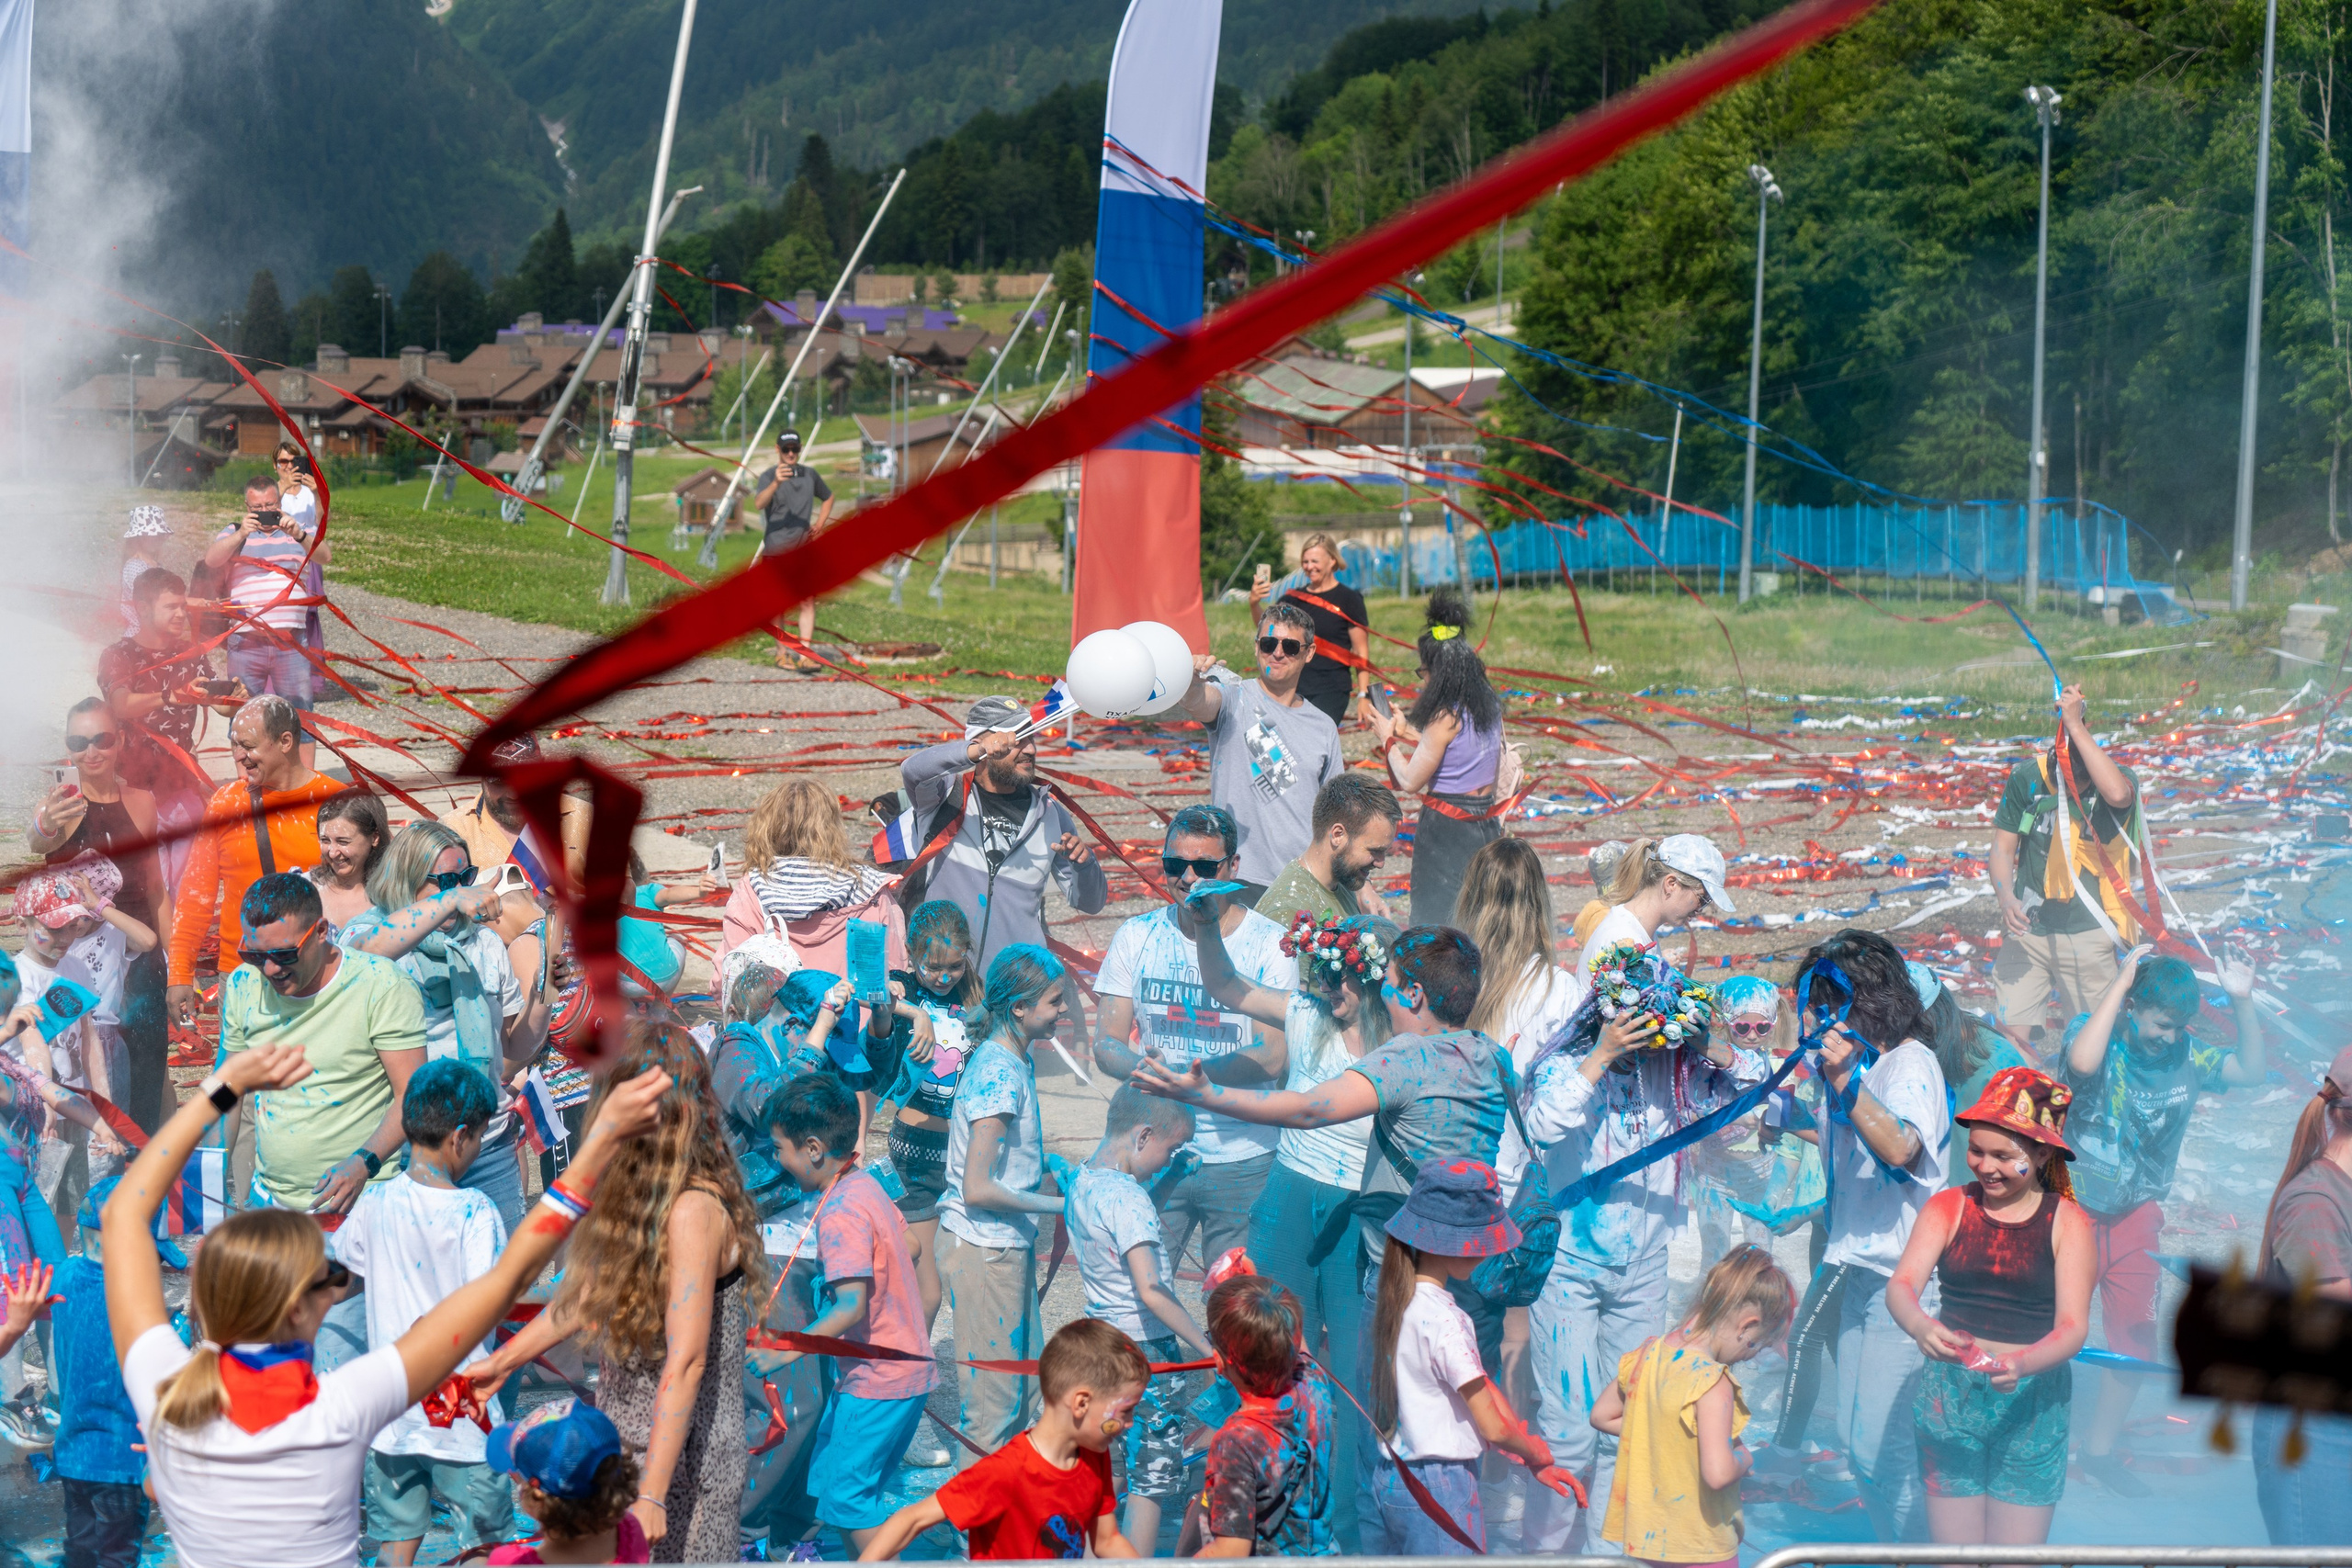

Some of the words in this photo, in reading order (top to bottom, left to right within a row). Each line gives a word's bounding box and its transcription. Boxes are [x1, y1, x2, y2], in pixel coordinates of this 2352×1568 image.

[1269, 730, 1297, 767] PARADISE
[1149, 982, 1203, 1007] DENIM
[1160, 1018, 1201, 1037] SINCE
[2137, 1098, 2163, 1108] YOUTH
[2164, 1093, 2188, 1106] SPIRIT
[1826, 1274, 1840, 1292] DREAM
[1814, 1293, 1828, 1313] BELIEVE
[1788, 1372, 1796, 1393] ACHIEVE
